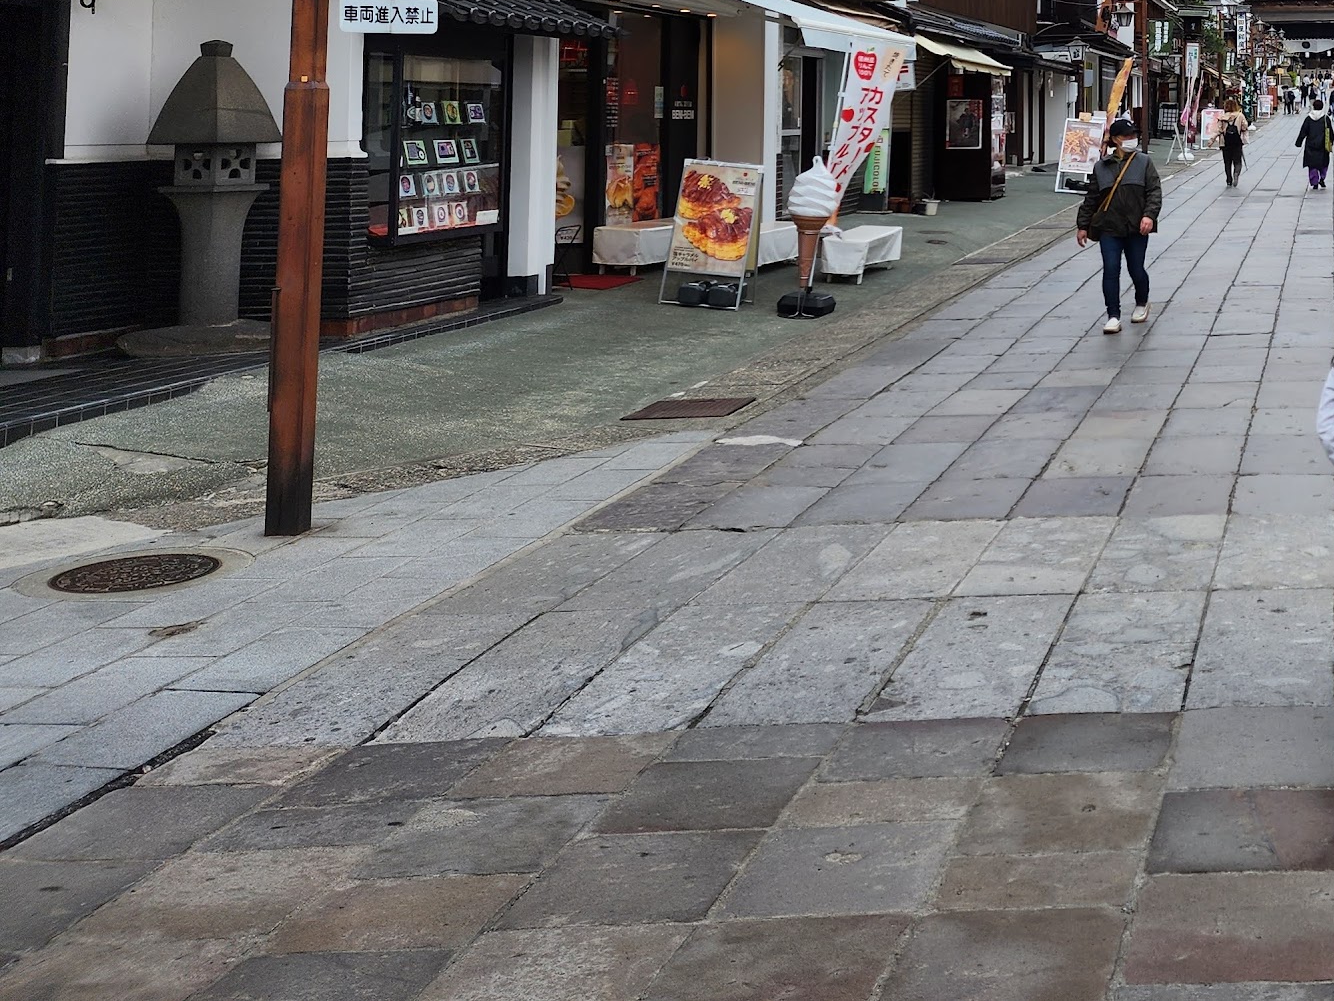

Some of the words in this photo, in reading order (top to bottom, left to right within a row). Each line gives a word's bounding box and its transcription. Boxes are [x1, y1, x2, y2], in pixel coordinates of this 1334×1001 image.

[343, 5, 434, 25] 車両進入禁止
[872, 144, 882, 193] FUJICOLO
